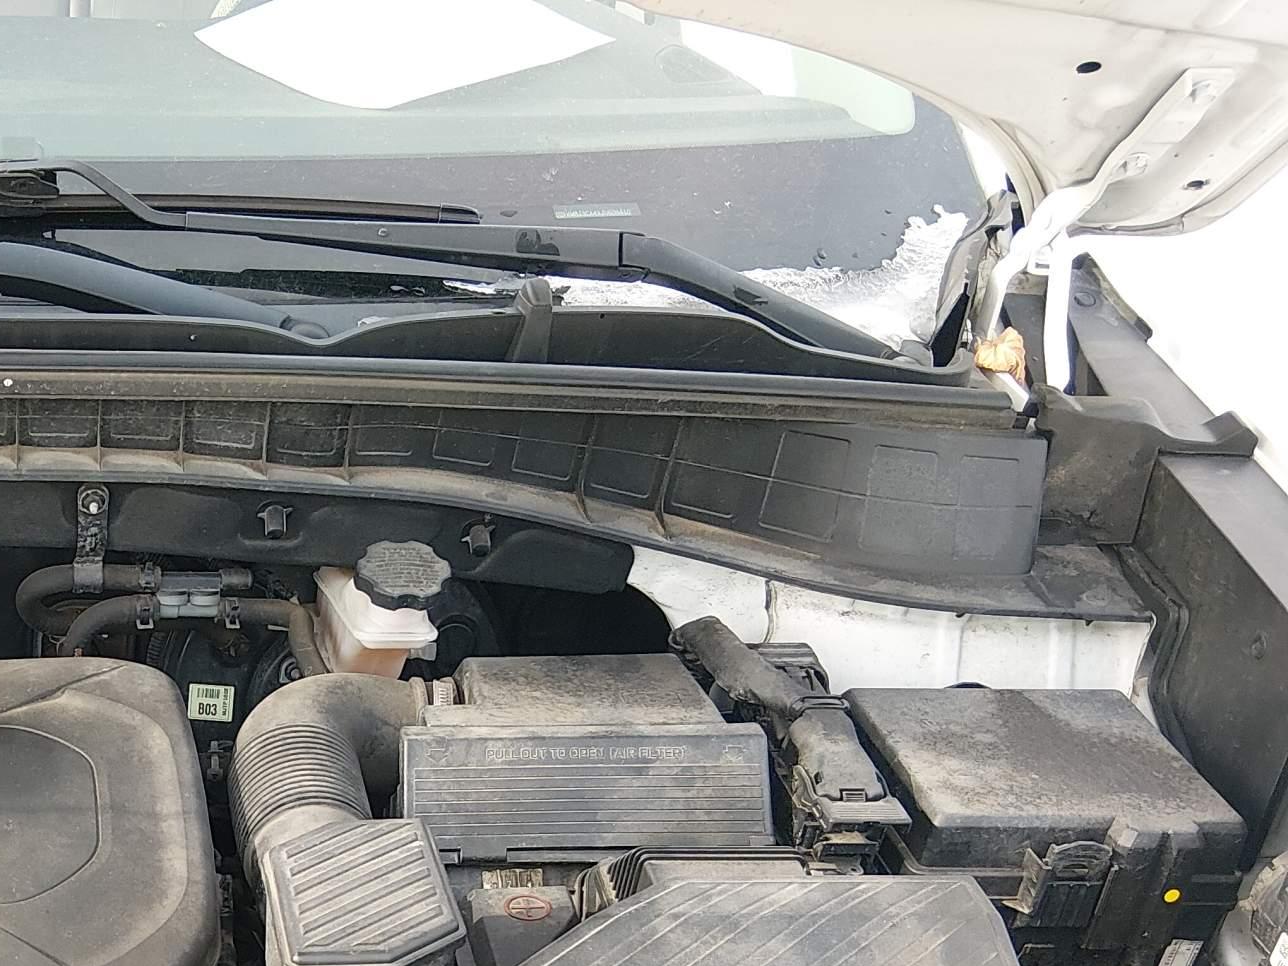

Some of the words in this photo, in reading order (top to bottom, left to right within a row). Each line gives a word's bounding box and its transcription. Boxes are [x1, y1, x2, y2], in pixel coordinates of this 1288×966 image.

[198, 702, 217, 716] B03
[485, 746, 519, 760] PULL
[520, 746, 546, 760] OUT
[551, 746, 566, 760] TO
